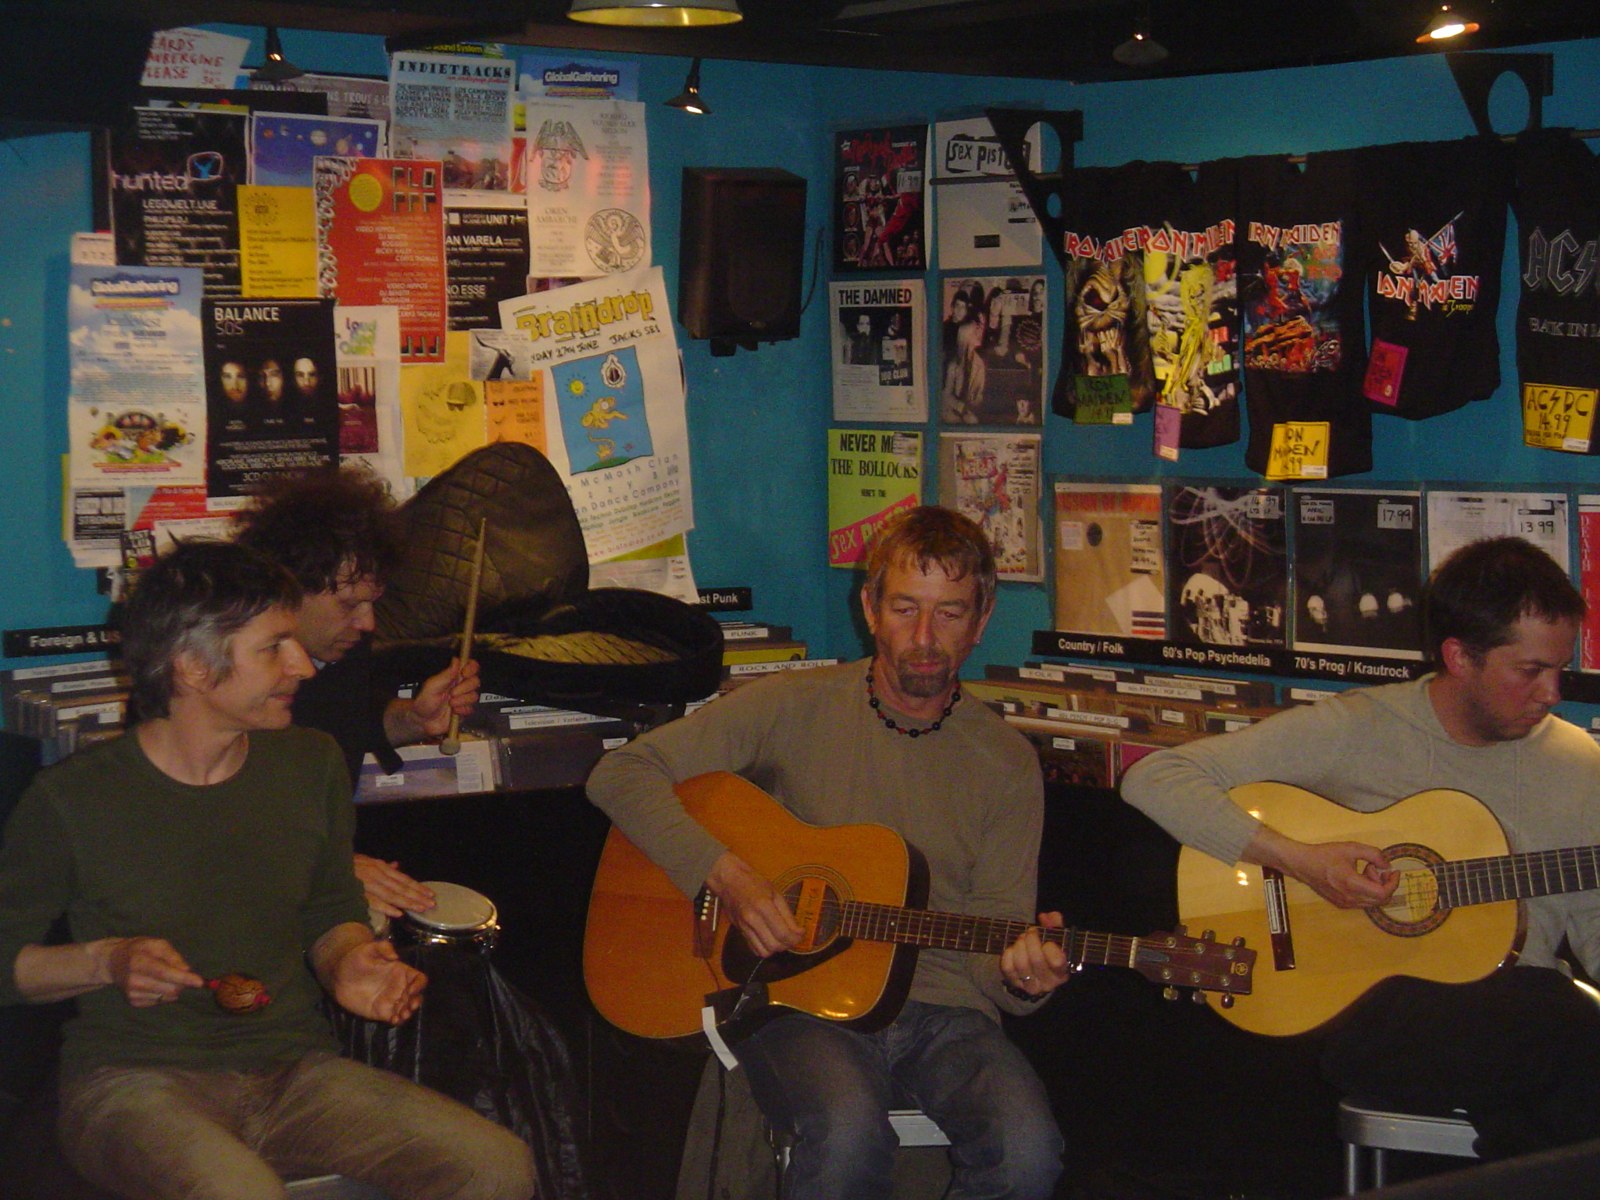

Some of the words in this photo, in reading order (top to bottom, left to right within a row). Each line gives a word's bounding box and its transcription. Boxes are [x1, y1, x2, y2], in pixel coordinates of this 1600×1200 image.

[399, 60, 511, 78] INDIETRACKS
[545, 71, 618, 85] GlobalGathering
[486, 214, 509, 225] UNIT
[463, 235, 504, 247] VARELA
[461, 284, 487, 296] ESSE
[838, 289, 860, 305] THE
[863, 288, 912, 305] DAMNED
[214, 307, 280, 323] BALANCE
[517, 290, 654, 343] Braindrop
[576, 340, 600, 352] JUNE
[608, 330, 643, 344] JACKS
[840, 434, 876, 453] NEVER
[881, 434, 895, 454] MI
[580, 464, 641, 488] McMash
[648, 453, 679, 469] Clan
[831, 459, 853, 475] THE
[592, 494, 628, 511] Dance
[632, 479, 680, 499] Company
[712, 592, 739, 605] Punk
[29, 633, 84, 649] Foreign
[86, 631, 98, 644] &
[1058, 638, 1096, 654] Country
[1102, 640, 1125, 655] Folk
[1162, 645, 1182, 659] 60's
[1185, 647, 1206, 662] Pop
[1208, 649, 1271, 667] Psychedelia
[1294, 656, 1317, 671] 70's
[1318, 659, 1345, 676] Prog
[1353, 661, 1410, 679] Krautrock
